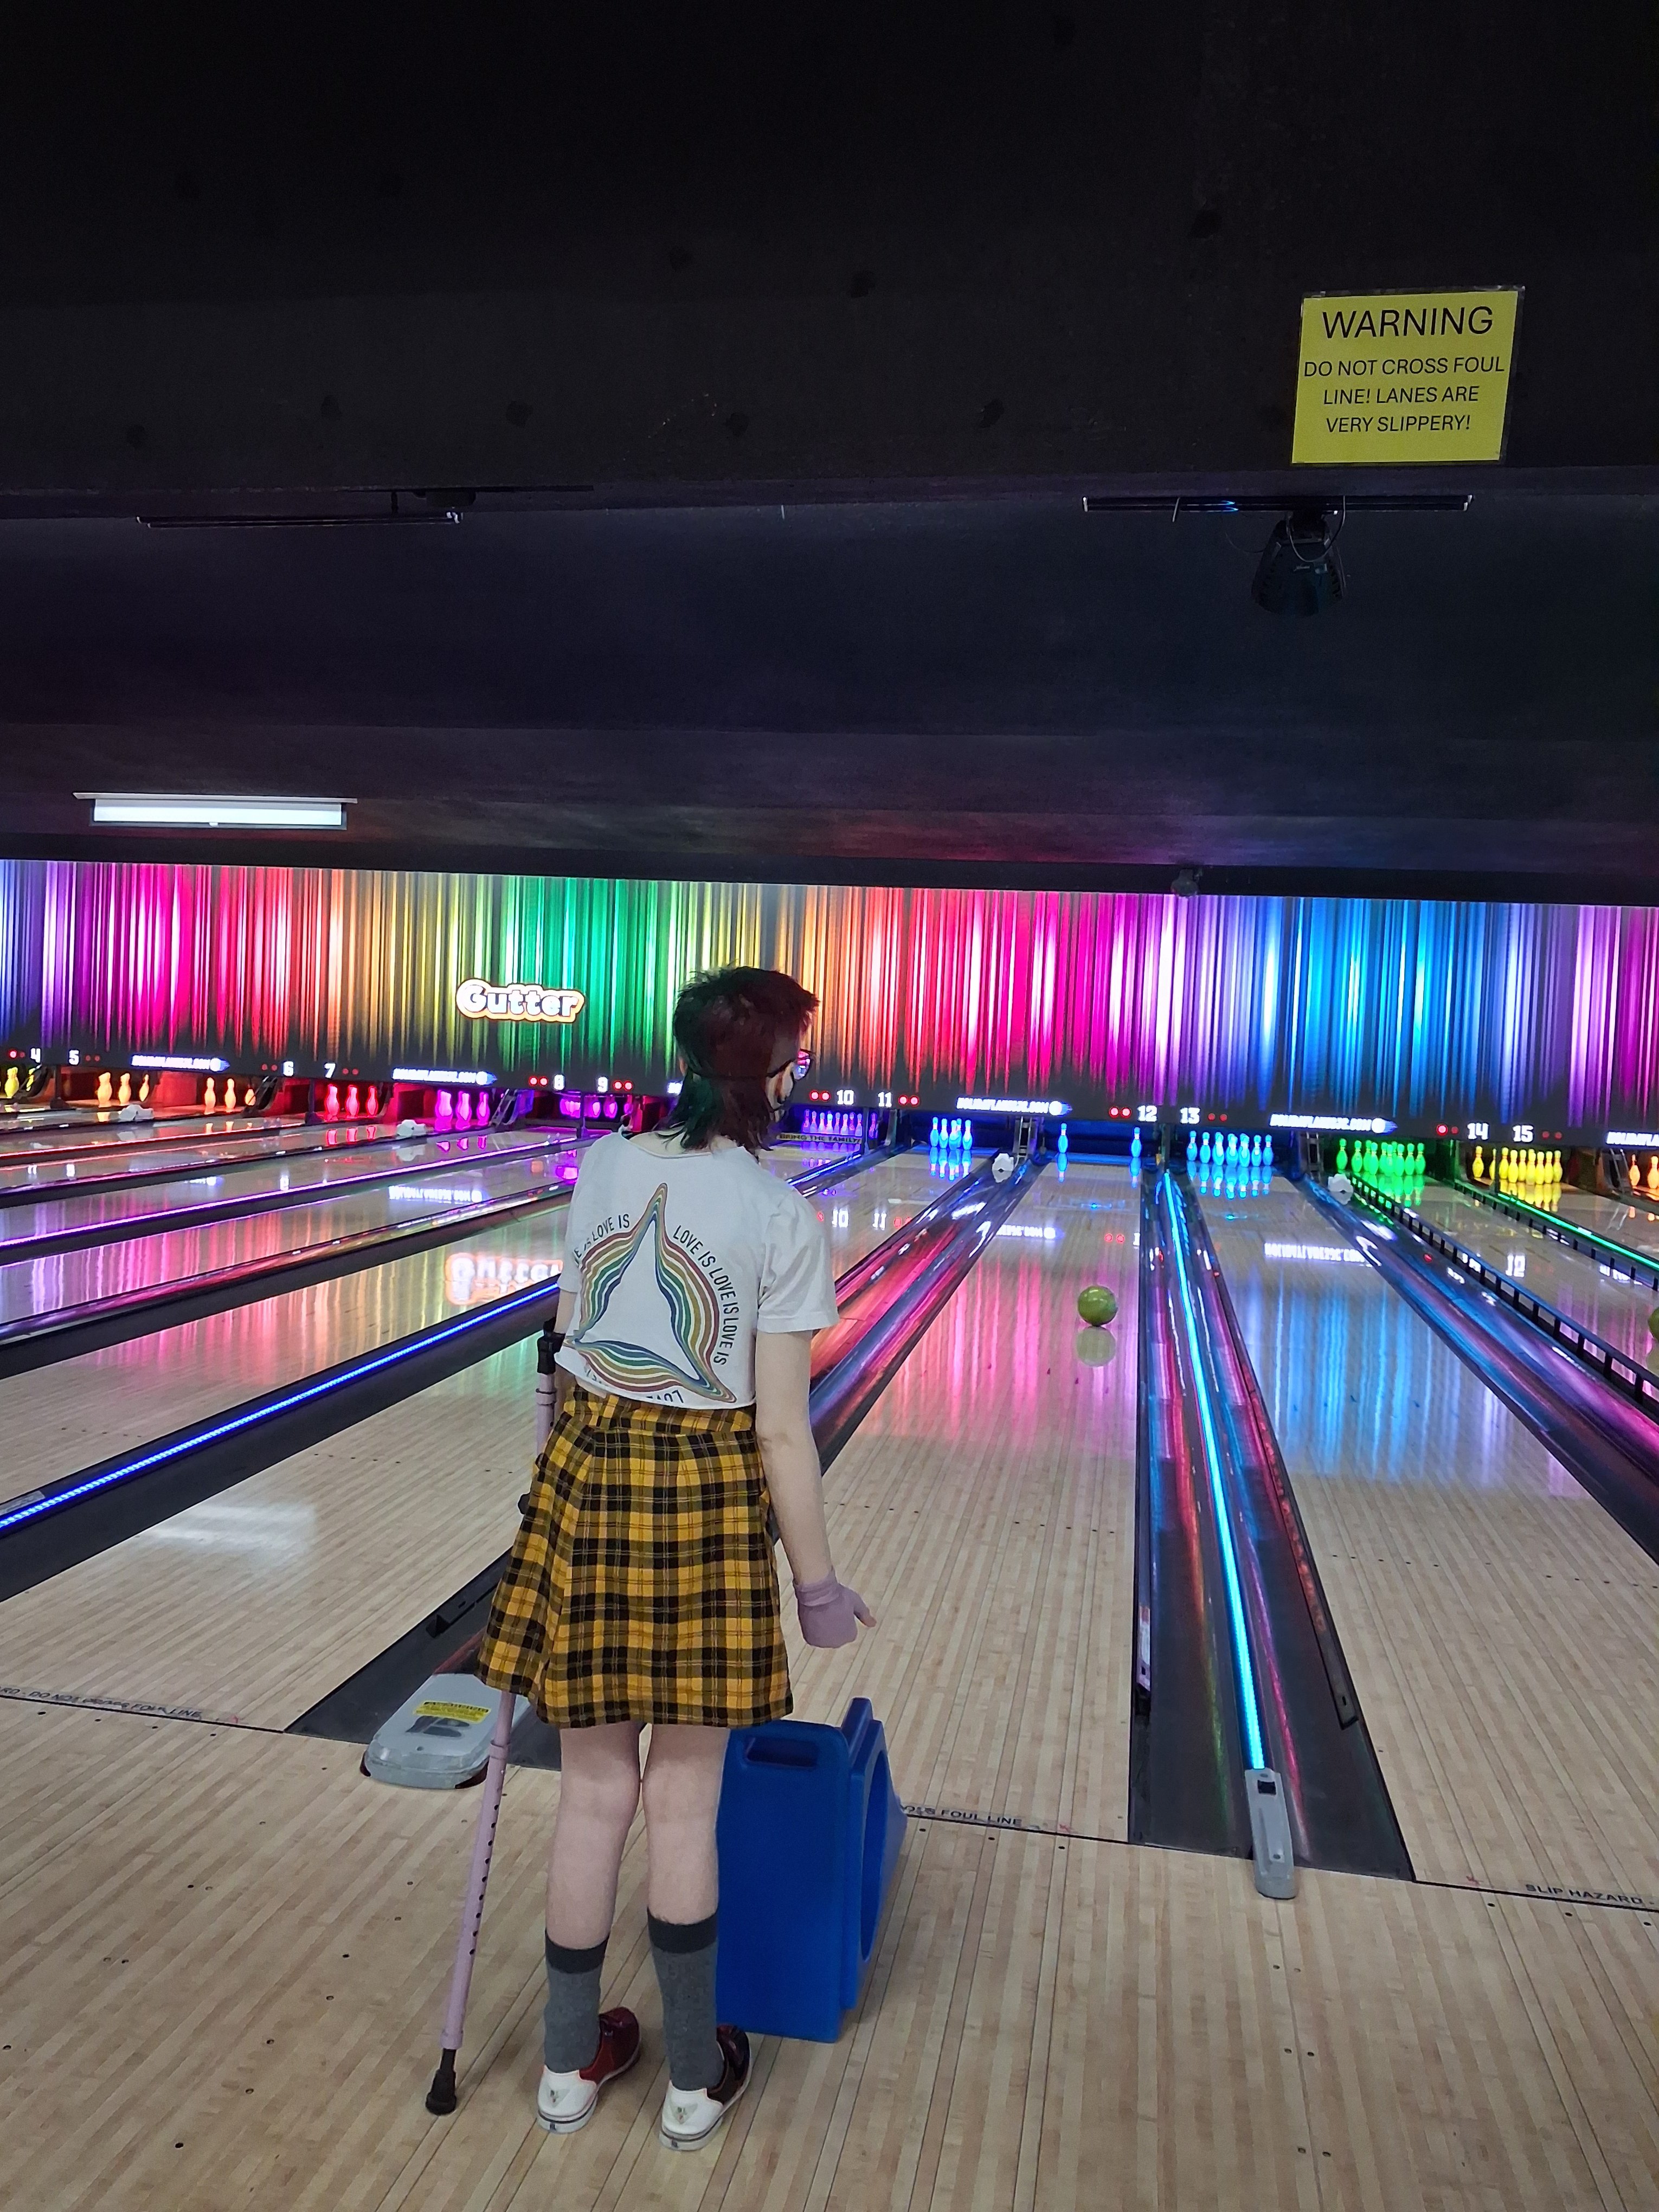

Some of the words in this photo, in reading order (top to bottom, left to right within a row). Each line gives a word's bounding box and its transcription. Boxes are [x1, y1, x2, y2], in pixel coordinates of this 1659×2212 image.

[1322, 306, 1494, 339] WARNING
[1303, 361, 1333, 377] DO
[1338, 359, 1378, 376] NOT
[1381, 357, 1448, 375] CROSS
[1453, 356, 1505, 374] FOUL
[1323, 388, 1371, 405] LINE!
[1376, 387, 1438, 403] LANES
[1442, 385, 1480, 402] ARE
[1326, 416, 1374, 433] VERY
[1377, 415, 1471, 432] SLIPPERY!
[461, 981, 582, 1020] Gutter
[30, 1047, 41, 1064] 4
[68, 1049, 80, 1065] 5
[282, 1060, 294, 1077] 6
[324, 1063, 336, 1079] 7
[553, 1074, 565, 1091] 8
[597, 1076, 608, 1093] 9
[836, 1089, 855, 1106] 10
[877, 1091, 893, 1108] 11
[1137, 1104, 1158, 1123] 12
[1180, 1107, 1201, 1125] 13
[1467, 1122, 1489, 1141] 14
[1512, 1124, 1534, 1143] 15
[591, 1217, 615, 1242] LOVE
[618, 1213, 630, 1229] IS
[672, 1225, 704, 1255] LOVE
[697, 1250, 717, 1268] IS
[708, 1267, 737, 1301] LOVE
[722, 1302, 740, 1314] IS
[719, 1317, 740, 1349] LOVE
[713, 1351, 729, 1366] IS
[941, 1809, 980, 1821] FOUL
[988, 1814, 1022, 1827] LINE
[1525, 1883, 1563, 1894] SLIP
[1568, 1889, 1643, 1905] HAZARD
